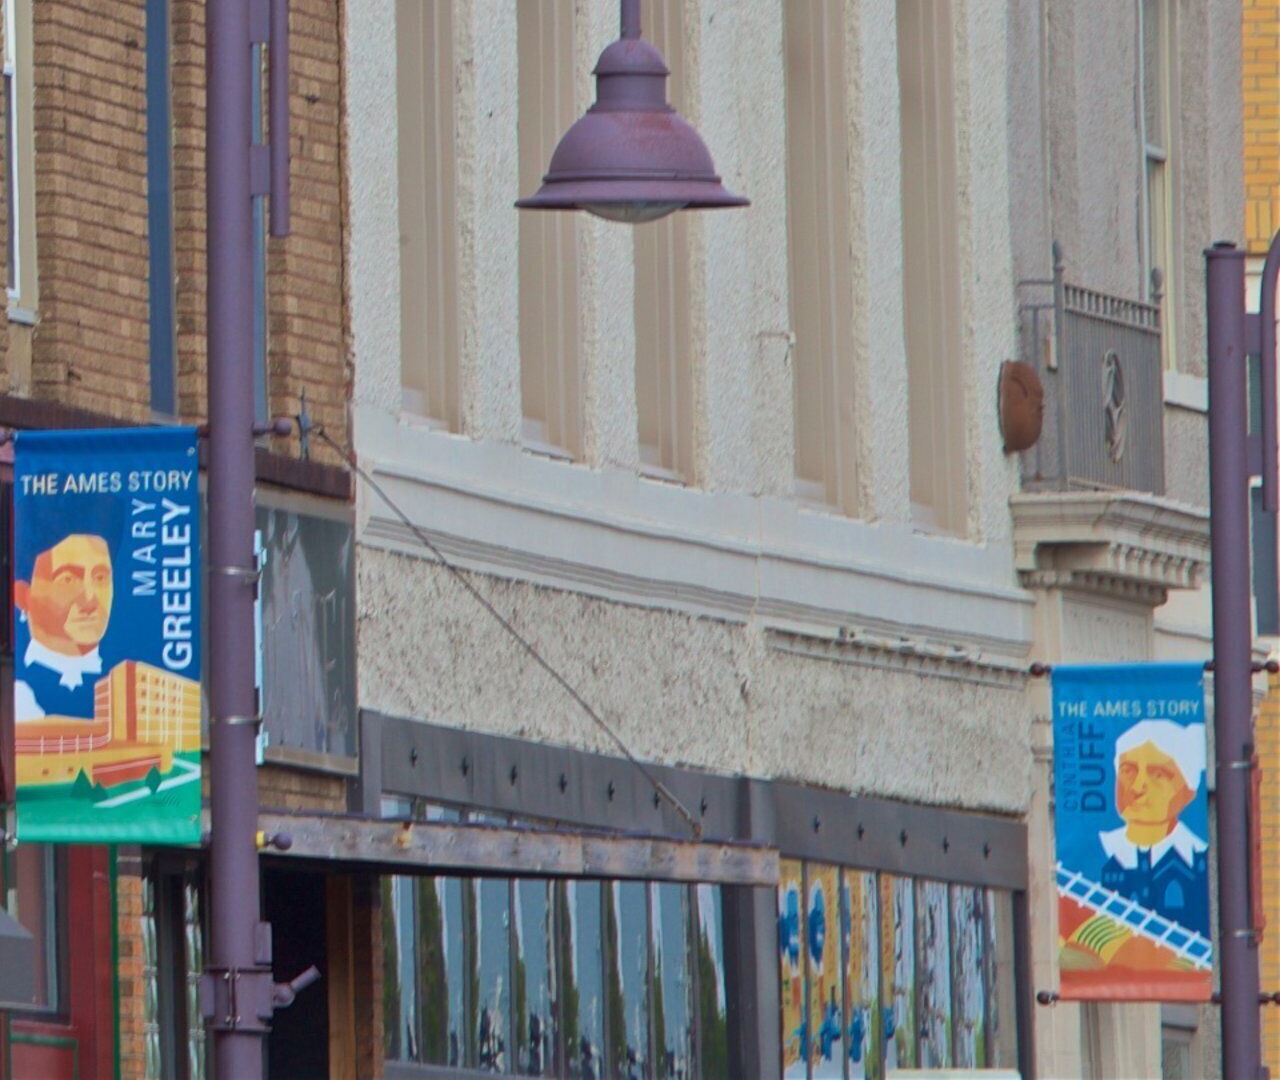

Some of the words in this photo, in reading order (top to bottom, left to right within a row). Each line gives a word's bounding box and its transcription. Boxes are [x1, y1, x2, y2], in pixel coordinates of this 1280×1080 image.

[21, 473, 58, 496] THE
[63, 471, 122, 494] AMES
[128, 470, 192, 493] STORY
[131, 498, 157, 596] MARY
[162, 497, 193, 669] GREELEY
[1058, 701, 1087, 717] THE
[1093, 700, 1142, 717] AMES
[1146, 699, 1200, 717] STORY
[1062, 721, 1079, 812] CYNTHIA
[1078, 721, 1107, 812] DUFF
